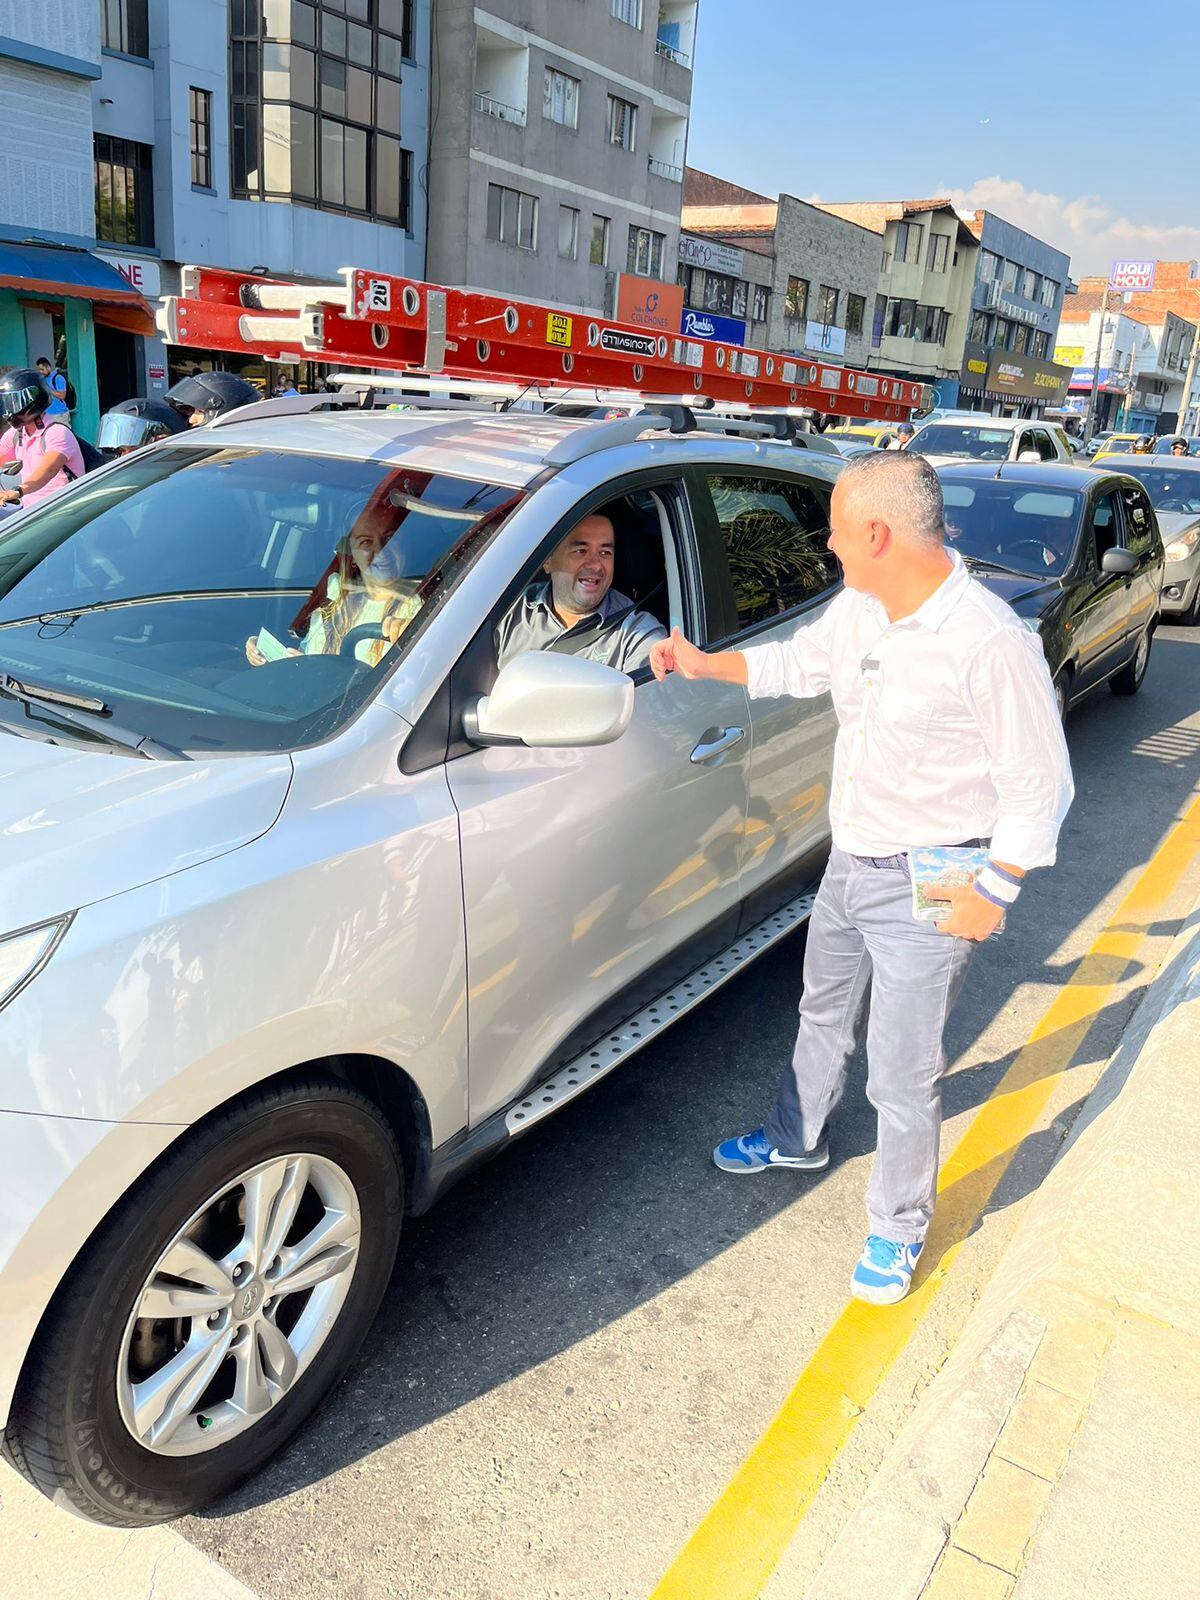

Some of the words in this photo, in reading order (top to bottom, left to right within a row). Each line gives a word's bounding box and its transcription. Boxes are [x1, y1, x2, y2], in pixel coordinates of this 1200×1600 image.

[1116, 263, 1151, 275] LIQUI
[1115, 275, 1150, 286] MOLY
[552, 315, 568, 329] TOP
[552, 330, 567, 344] PRO
[602, 334, 648, 351] LOUISVILLE
